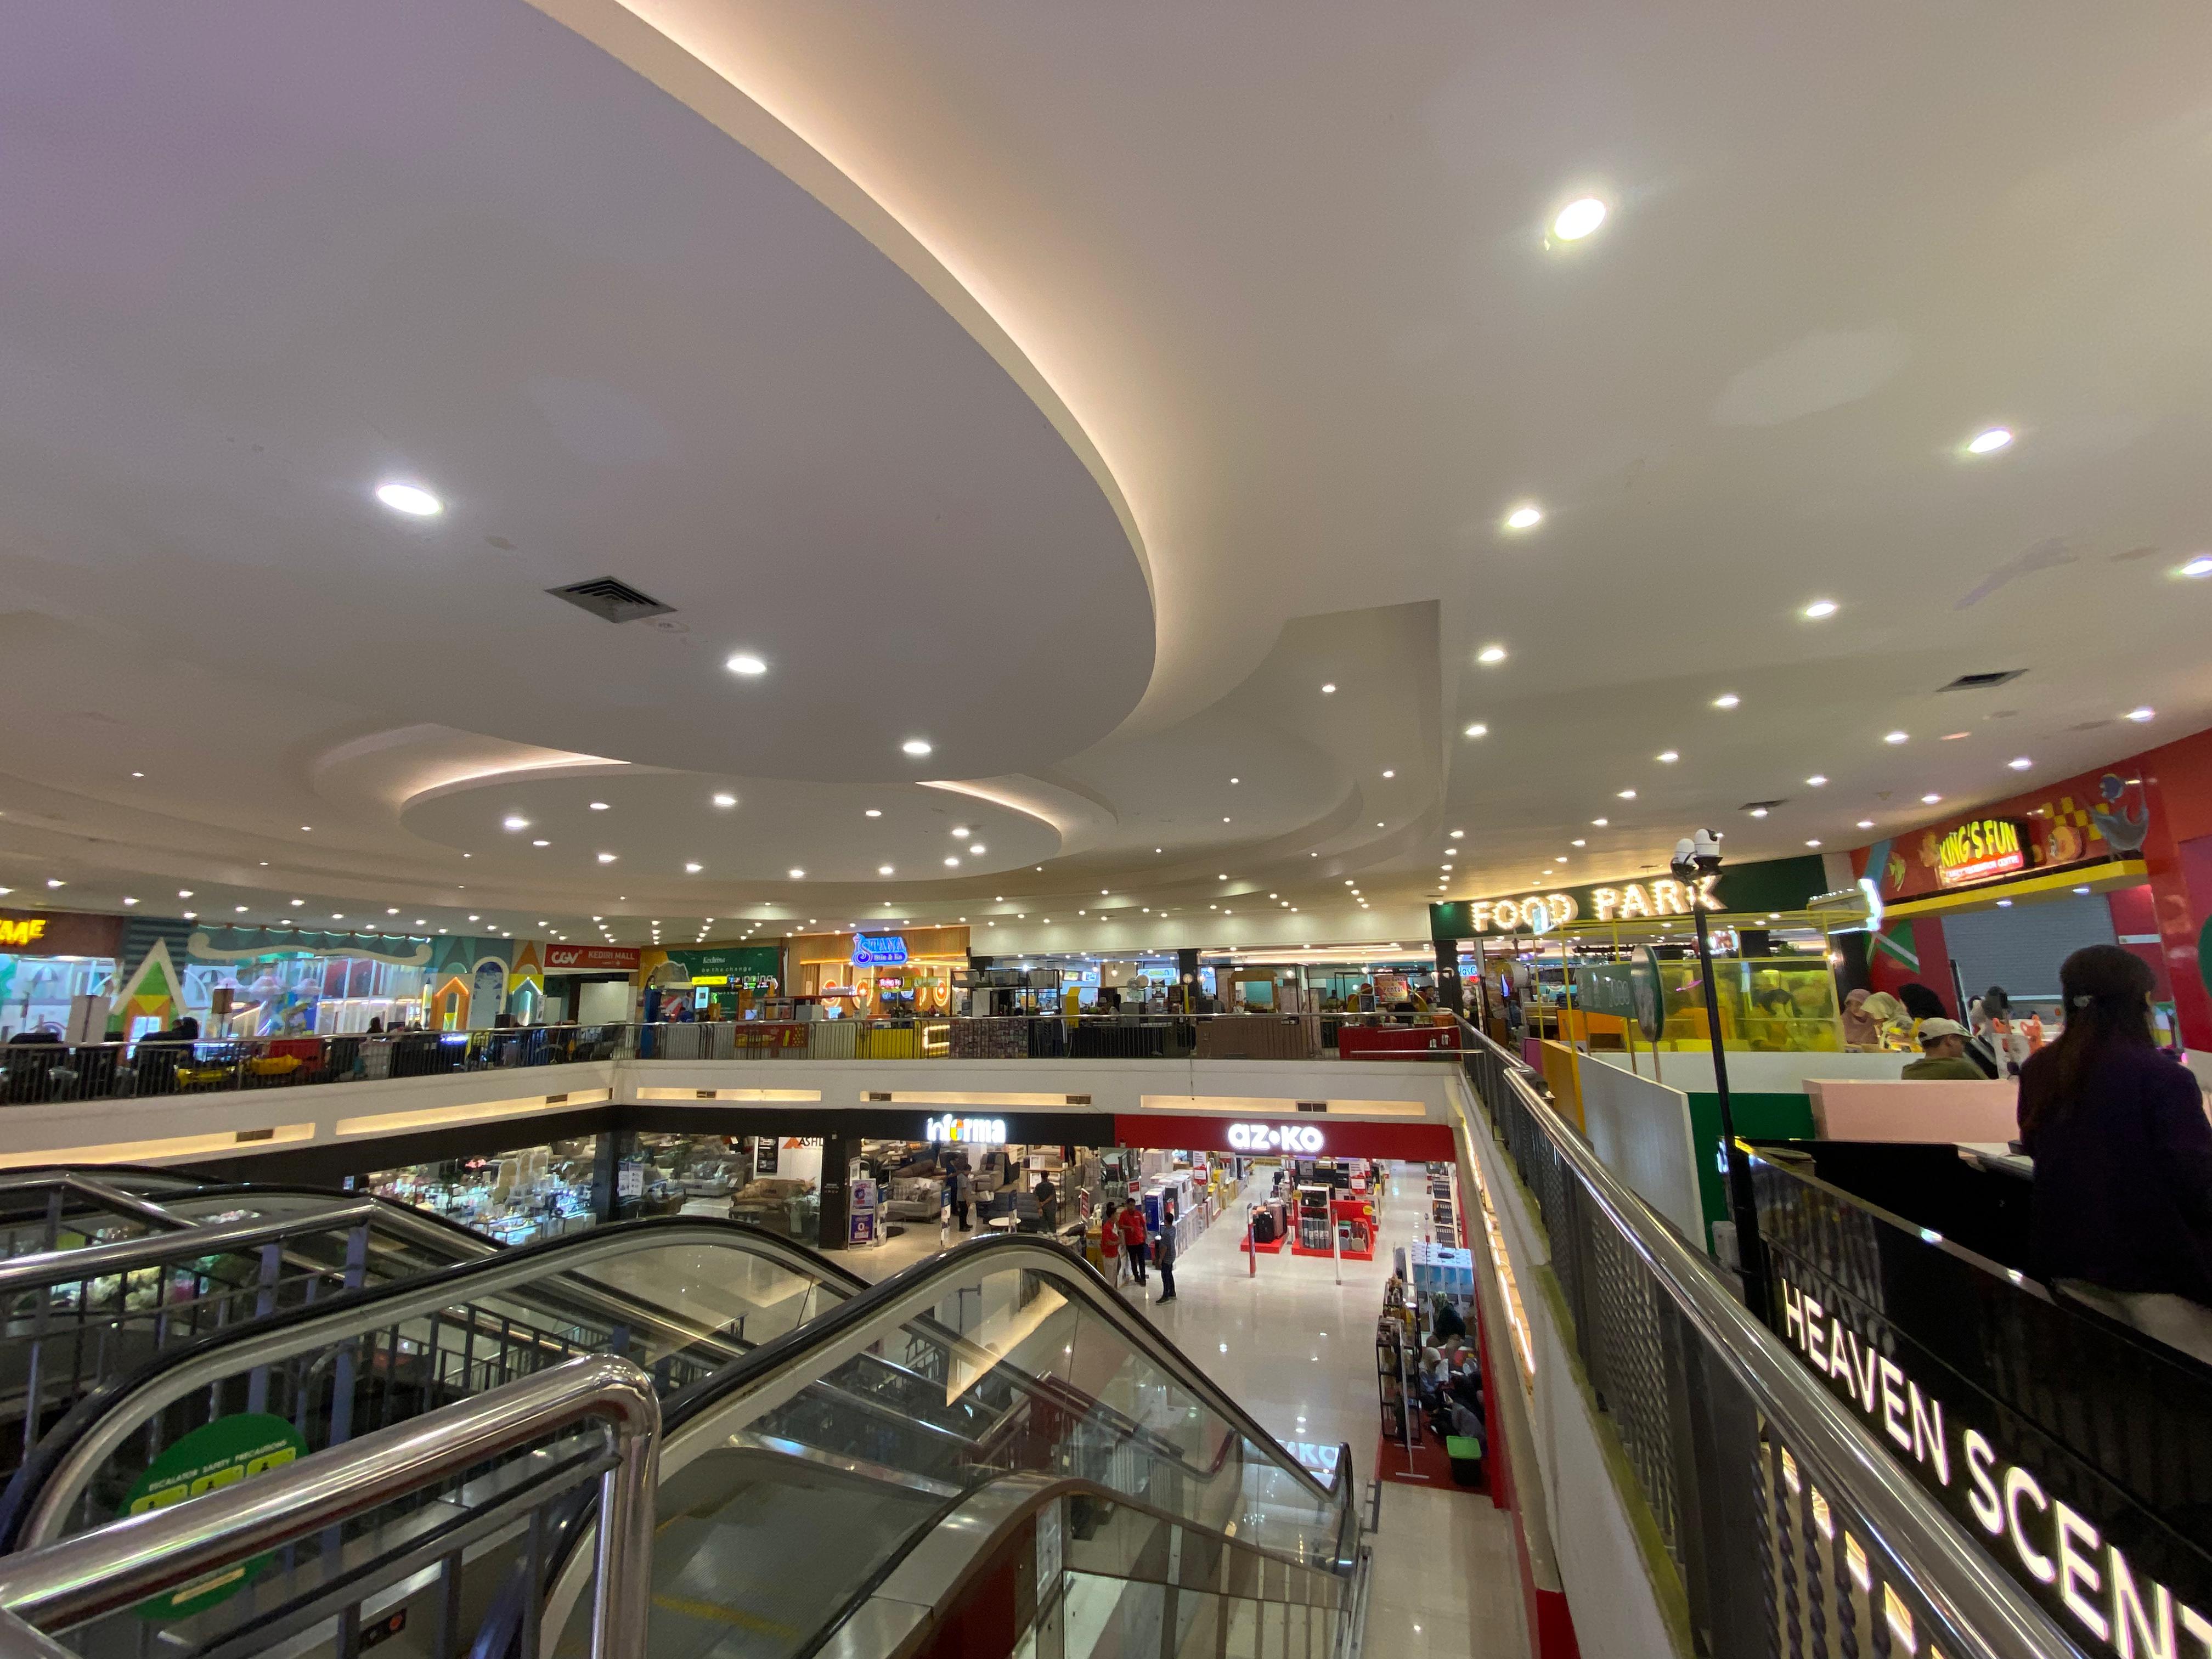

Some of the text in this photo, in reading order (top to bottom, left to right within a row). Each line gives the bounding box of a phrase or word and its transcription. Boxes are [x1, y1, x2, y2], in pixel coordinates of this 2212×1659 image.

[1939, 820, 2019, 868] KING'S FUN
[1471, 874, 1729, 932] FOOD PARK
[0, 919, 46, 945] ME
[853, 933, 906, 958] ISTANA
[551, 950, 579, 964] CGV
[588, 951, 613, 959] KEDIRI
[927, 1114, 1006, 1143] informa
[1782, 1278, 1950, 1486] HEAVEN
